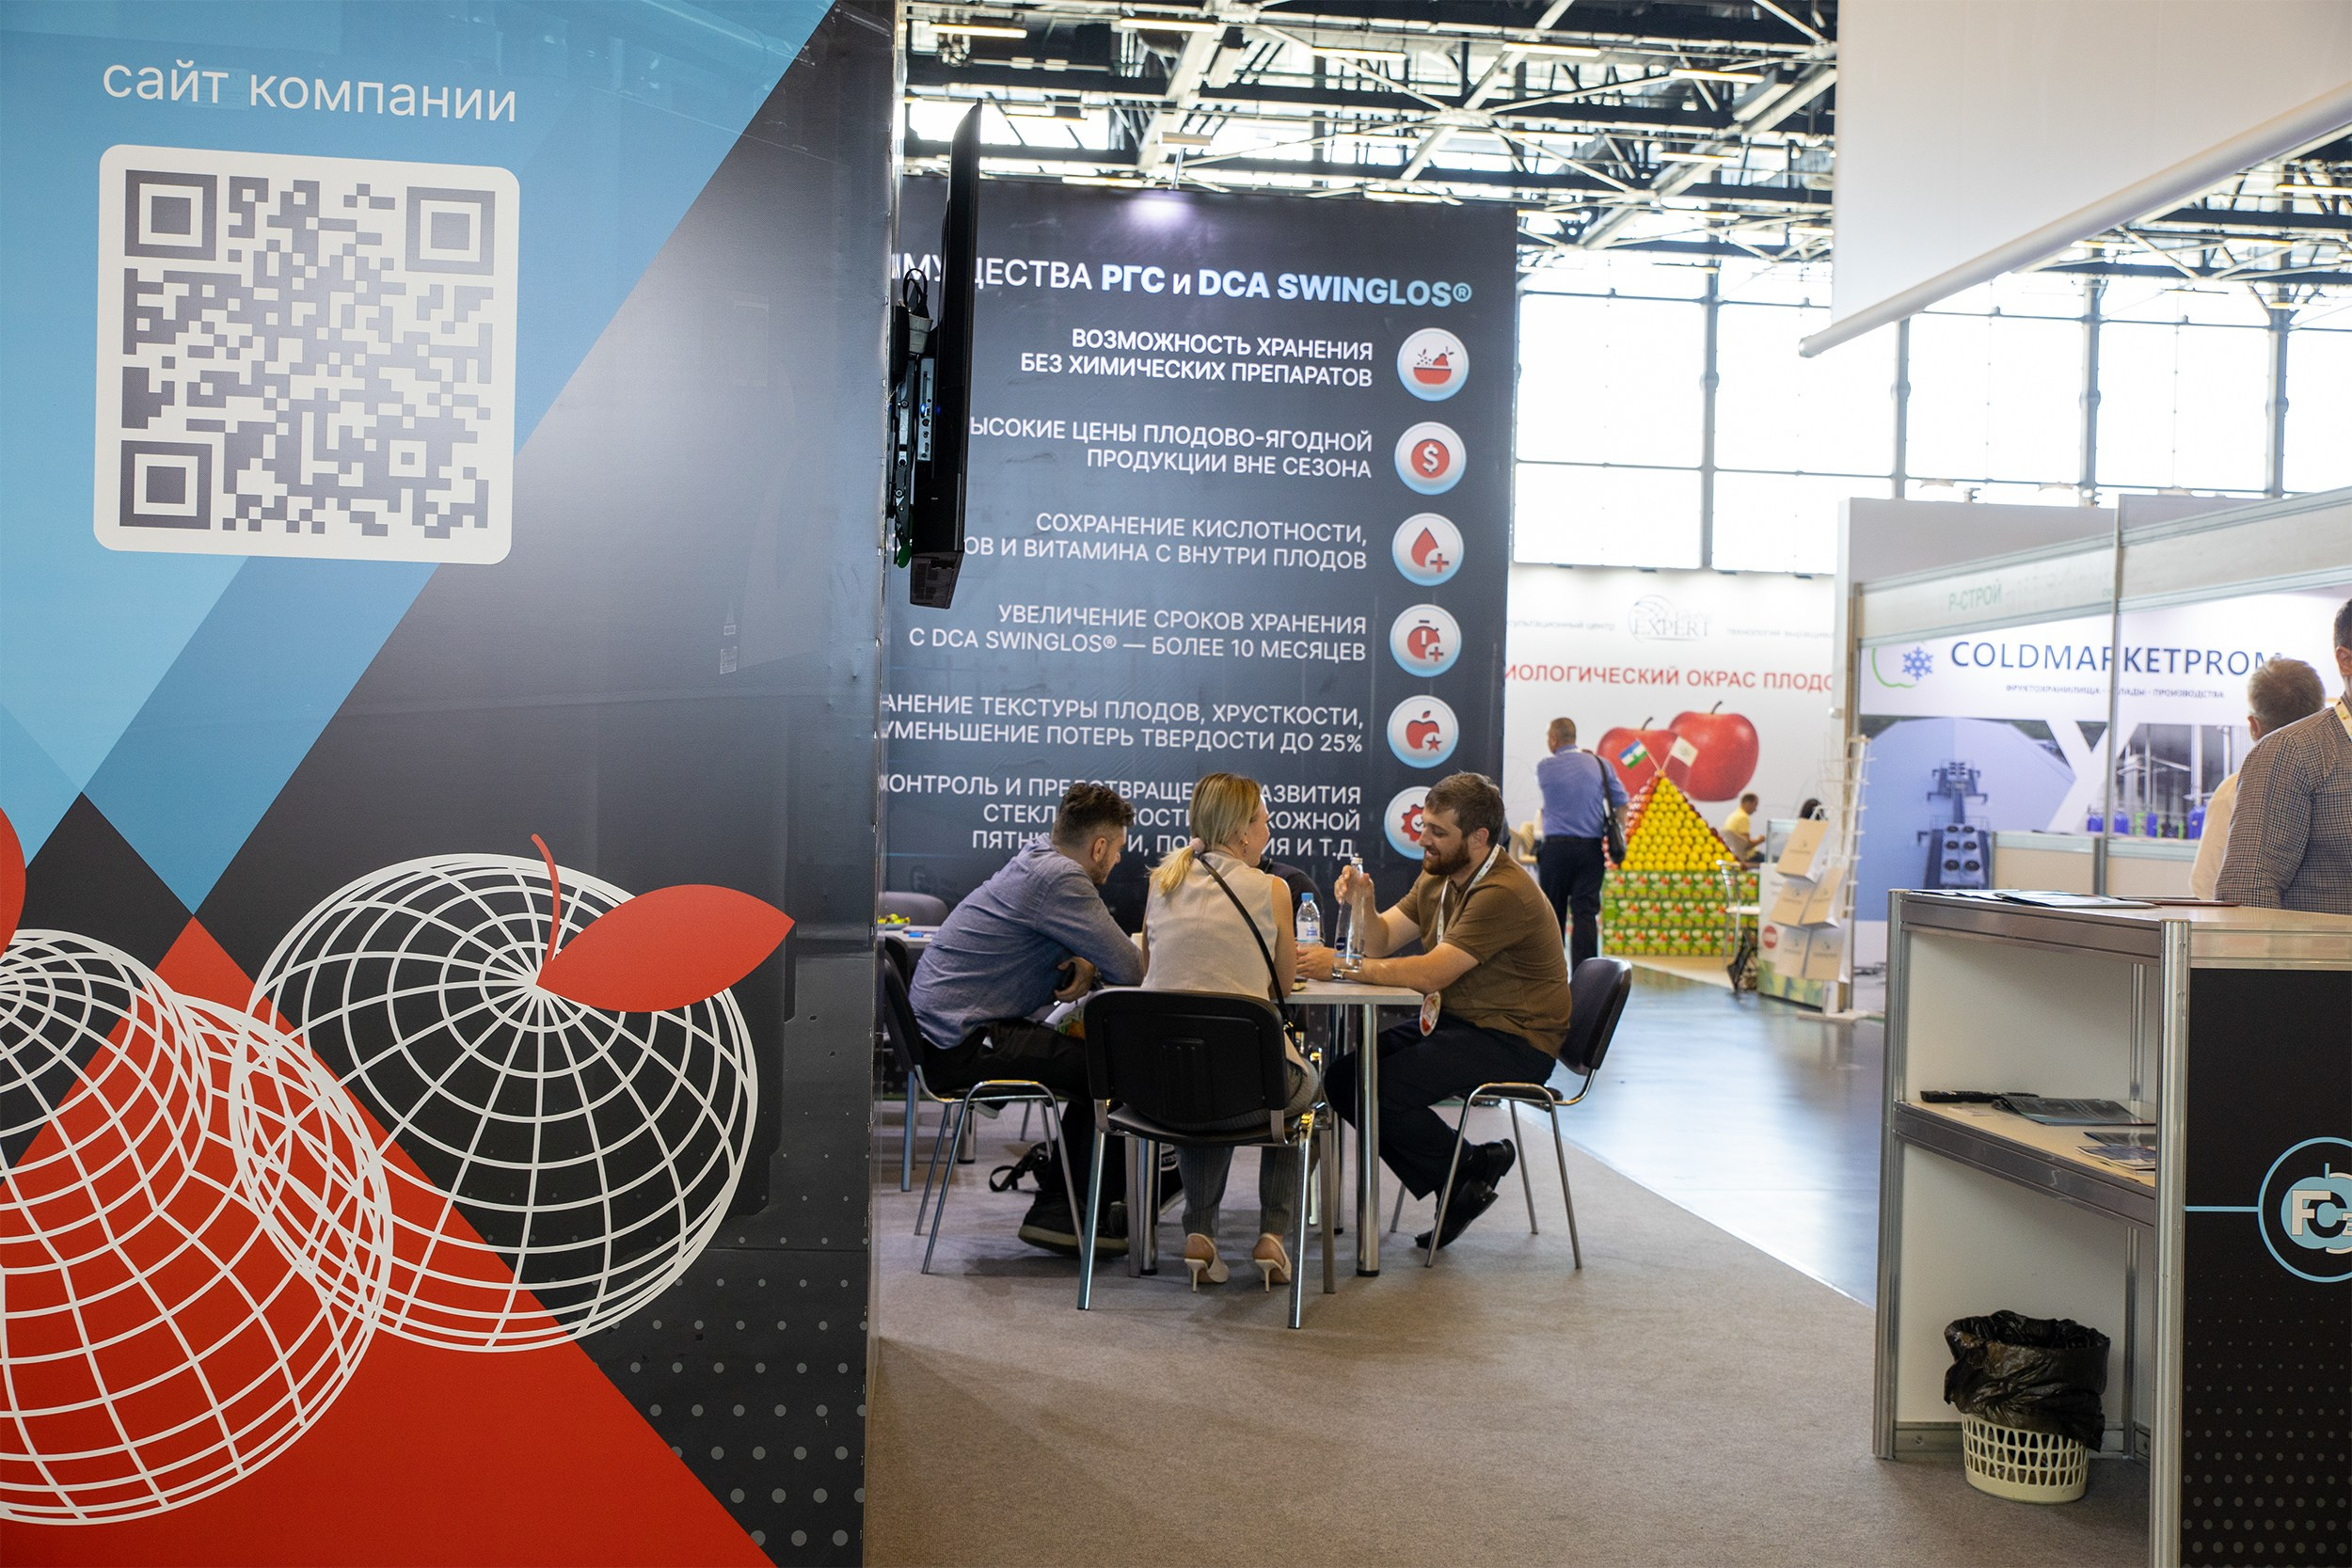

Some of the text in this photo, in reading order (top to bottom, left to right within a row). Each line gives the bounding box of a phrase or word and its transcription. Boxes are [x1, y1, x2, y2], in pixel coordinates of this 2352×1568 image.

[103, 59, 515, 121] сайт компании
[891, 253, 1471, 306] МЕСТВА РГС и DCA SWINGLOS®
[1073, 328, 1373, 360] ВОЗМОЖНОСТЬ ХРАНЕНИЯ
[1022, 353, 1372, 387] БЕЗ ХИМИЧЕСКИХ ПРЕПАРАТОВ
[1073, 423, 1136, 443] ЦЕНЫ
[1143, 424, 1373, 452] ПЛОДОВО-ЯГОДНОЙ
[1088, 446, 1371, 478] ПРОДУКЦИИ ВНЕ СЕЗОНА
[1037, 513, 1367, 546] СОХРАНЕНИЕ КИСЛОТНОСТИ,
[1002, 538, 1016, 556] И
[1025, 539, 1149, 561] ВИТАМИНА
[1156, 545, 1170, 562] С
[1179, 545, 1265, 565] ВНУТРИ
[1274, 548, 1366, 572] ПЛОДОВ
[999, 605, 1365, 634] УВЕЛИЧЕНИЕ СРОКОВ ХРАНЕНИЯ
[910, 627, 925, 645] С
[932, 629, 978, 647] DCA
[986, 631, 1117, 652] SWINGLOS®
[1152, 637, 1223, 656] БОЛЕЕ
[1232, 640, 1253, 657] 10
[1262, 641, 1365, 663] МЕСЯЦЕВ
[1686, 670, 1755, 688] ОКРАС
[980, 697, 1097, 718] ТЕКСТУРЫ
[1105, 701, 1204, 724] ПЛОДОВ,
[1213, 705, 1363, 729] ХРУСТКОСТИ,
[1047, 726, 1134, 746] ПОТЕРЬ
[1141, 729, 1274, 752] ТВЕРДОСТИ
[1280, 734, 1313, 753] ДО
[1321, 734, 1362, 752] 25%
[1006, 778, 1021, 795] И
[1261, 784, 1360, 804] АЗВИТИЯ
[1297, 838, 1311, 856] И
[1319, 839, 1359, 861] Т.Д.
